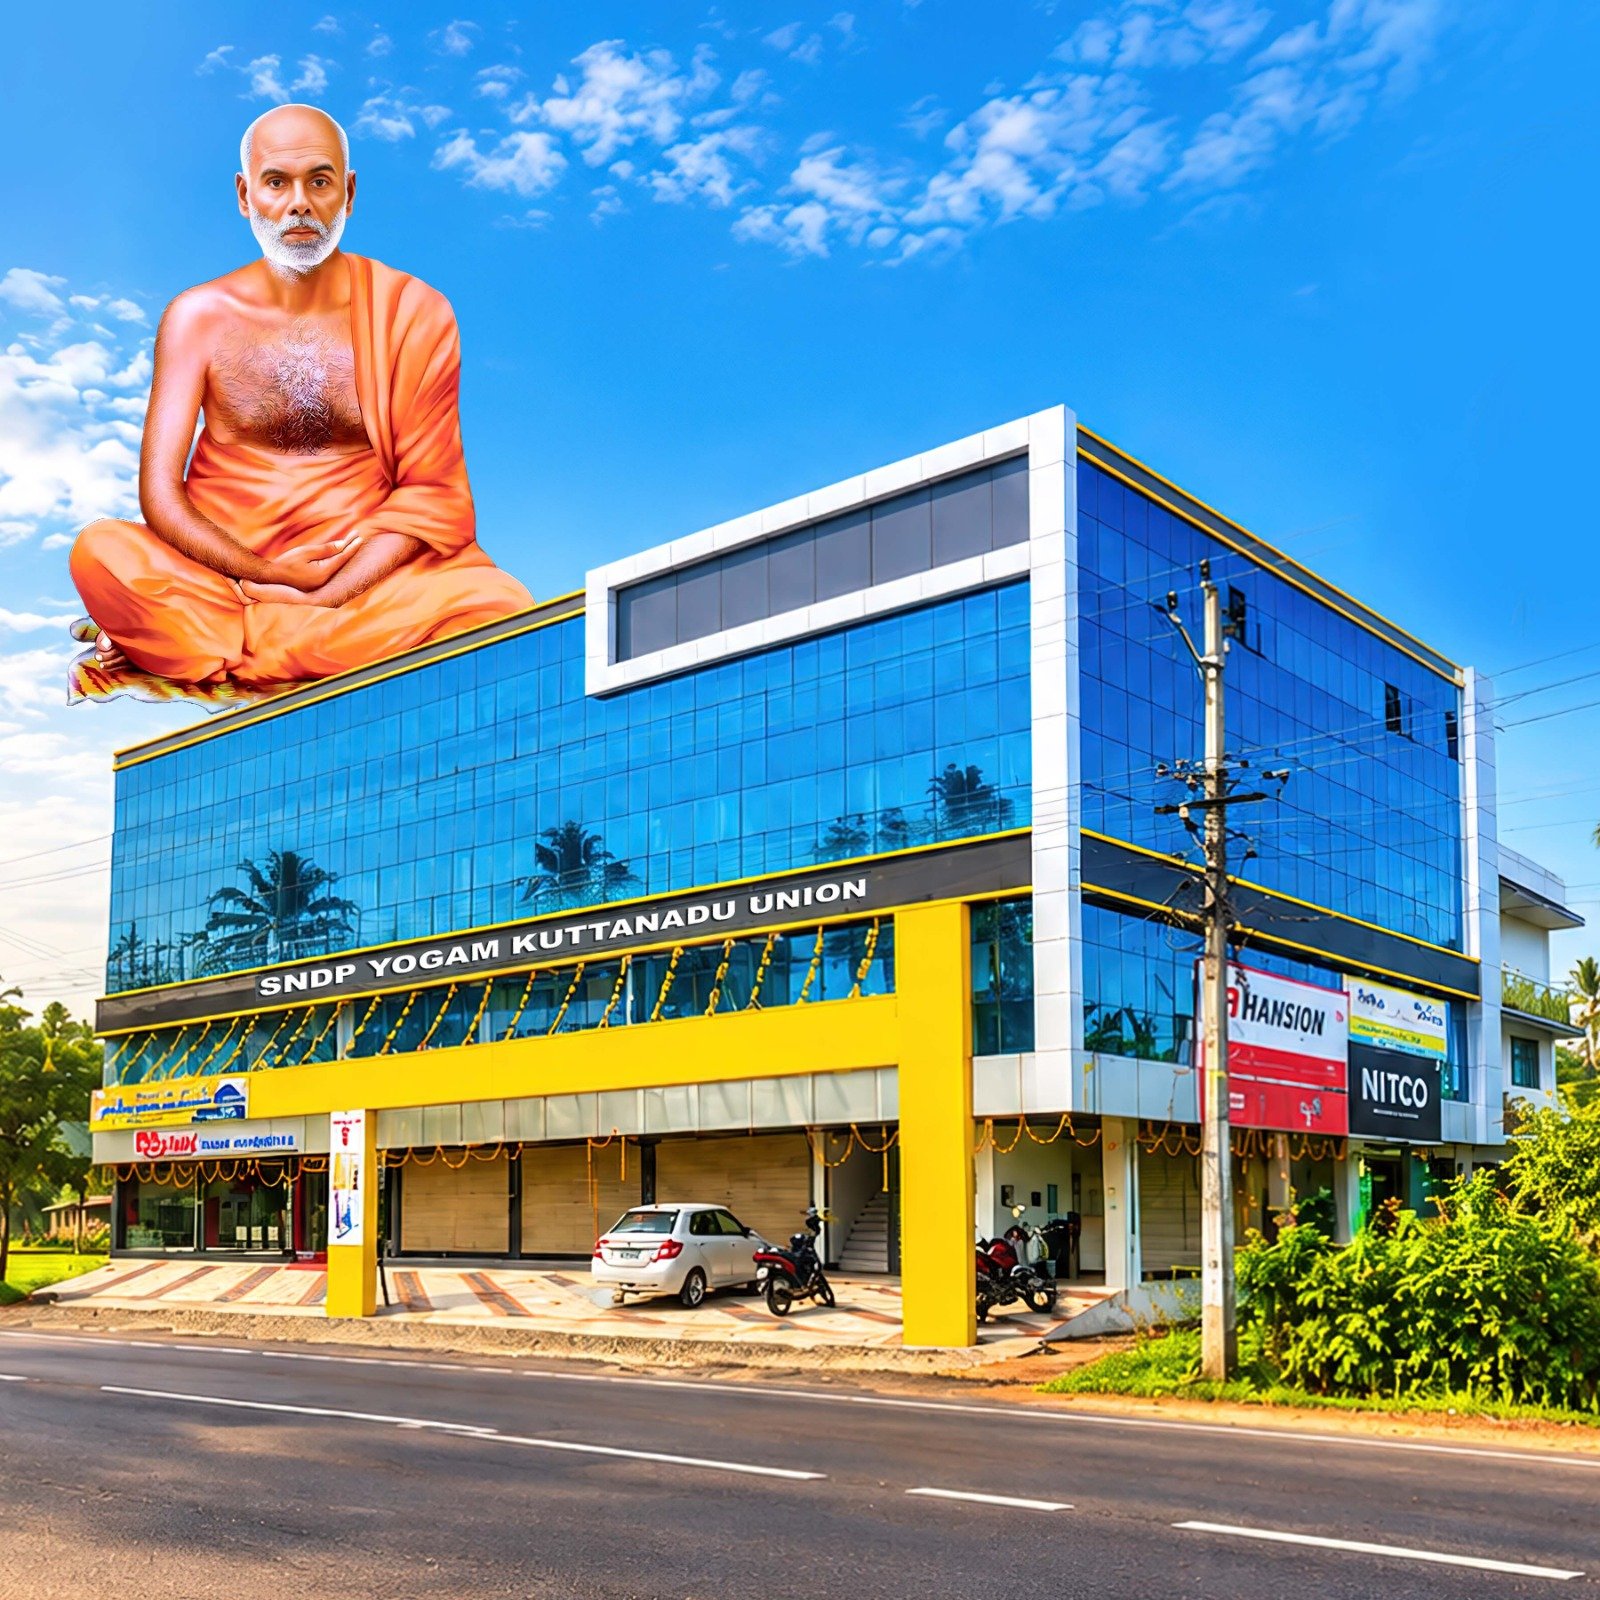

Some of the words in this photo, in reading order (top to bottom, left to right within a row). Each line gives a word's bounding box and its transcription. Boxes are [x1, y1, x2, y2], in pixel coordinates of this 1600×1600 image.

[259, 963, 356, 996] SNDP
[367, 939, 499, 977] YOGAM
[512, 900, 736, 955] KUTTANADU
[749, 878, 867, 914] UNION
[1362, 1067, 1428, 1109] NITCO
